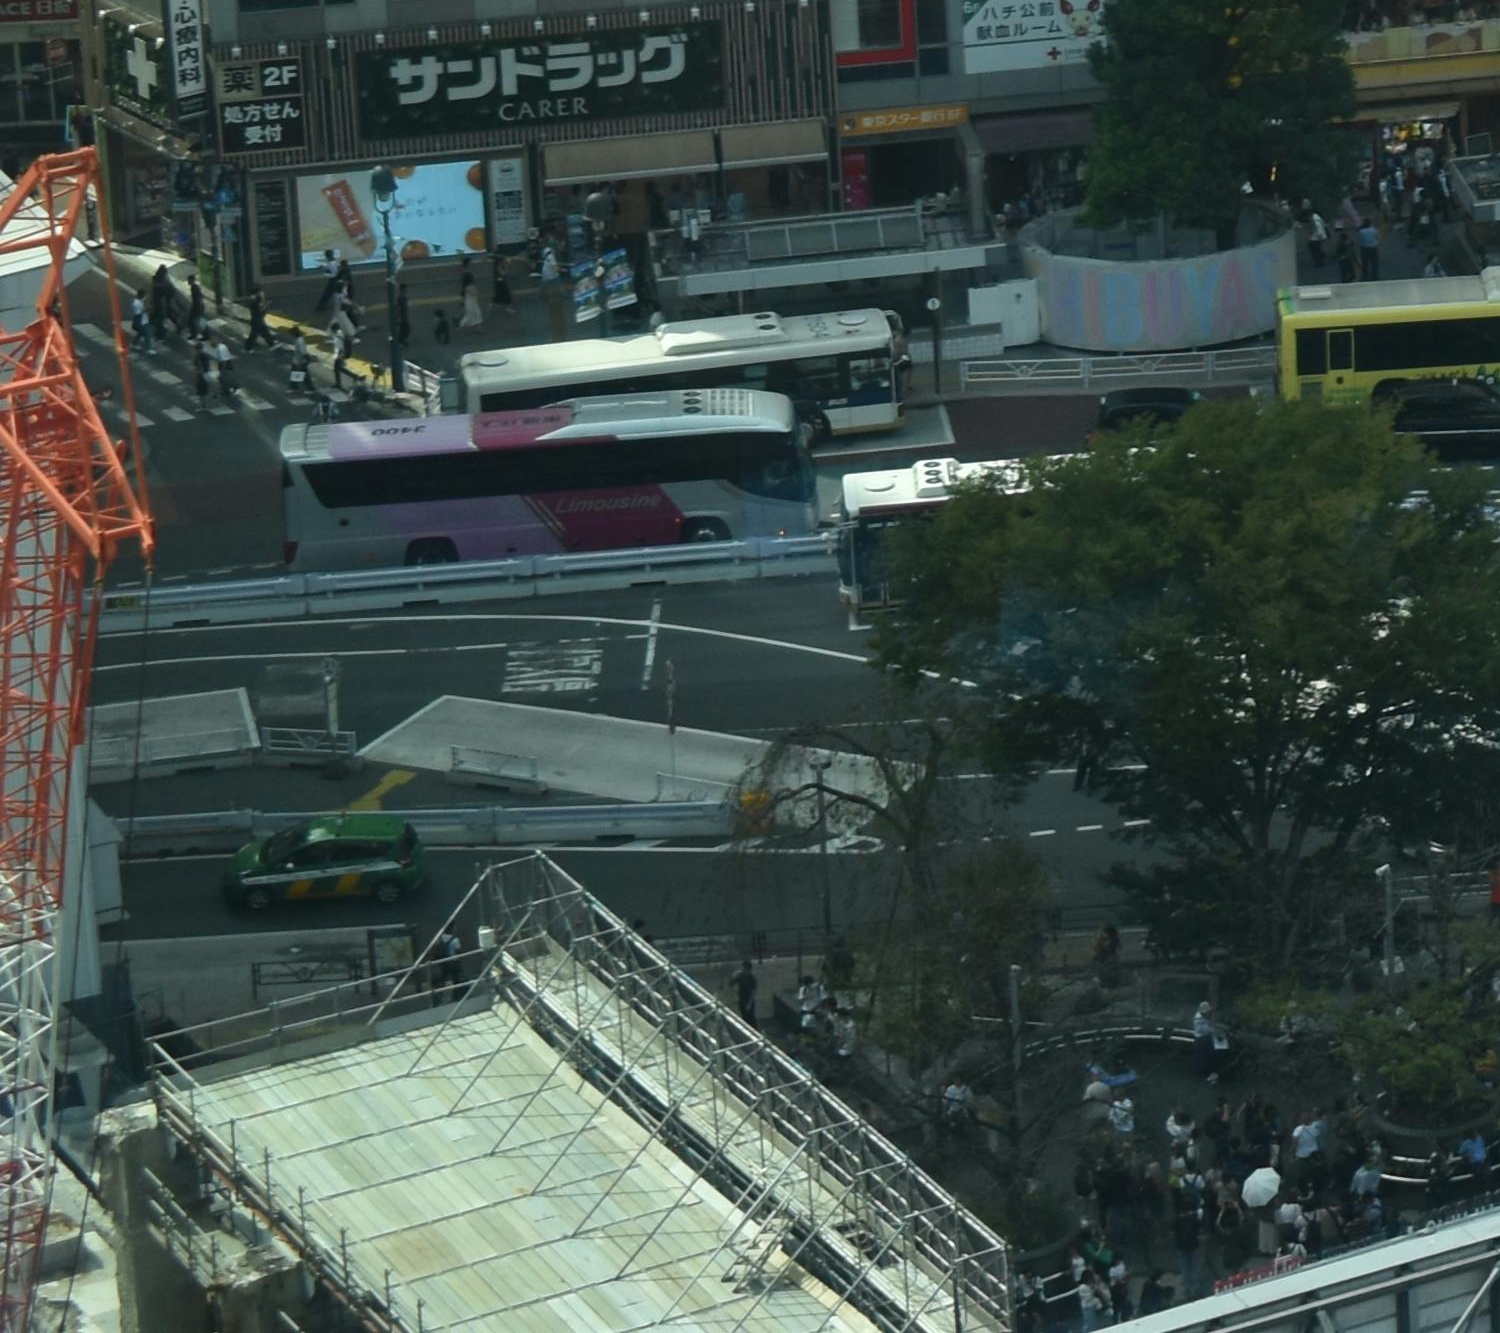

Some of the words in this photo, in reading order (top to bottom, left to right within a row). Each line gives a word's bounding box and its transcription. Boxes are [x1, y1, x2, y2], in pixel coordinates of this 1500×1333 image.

[982, 1, 1055, 21] ハチ公前
[975, 18, 1062, 41] 献血ルーム
[223, 66, 255, 94] 薬
[262, 63, 298, 89] 2F
[388, 34, 690, 105] サンドラッグ
[223, 99, 300, 125] 処方せん
[498, 95, 591, 123] CARER
[244, 123, 284, 146] 受付
[554, 491, 663, 514] Limousine
